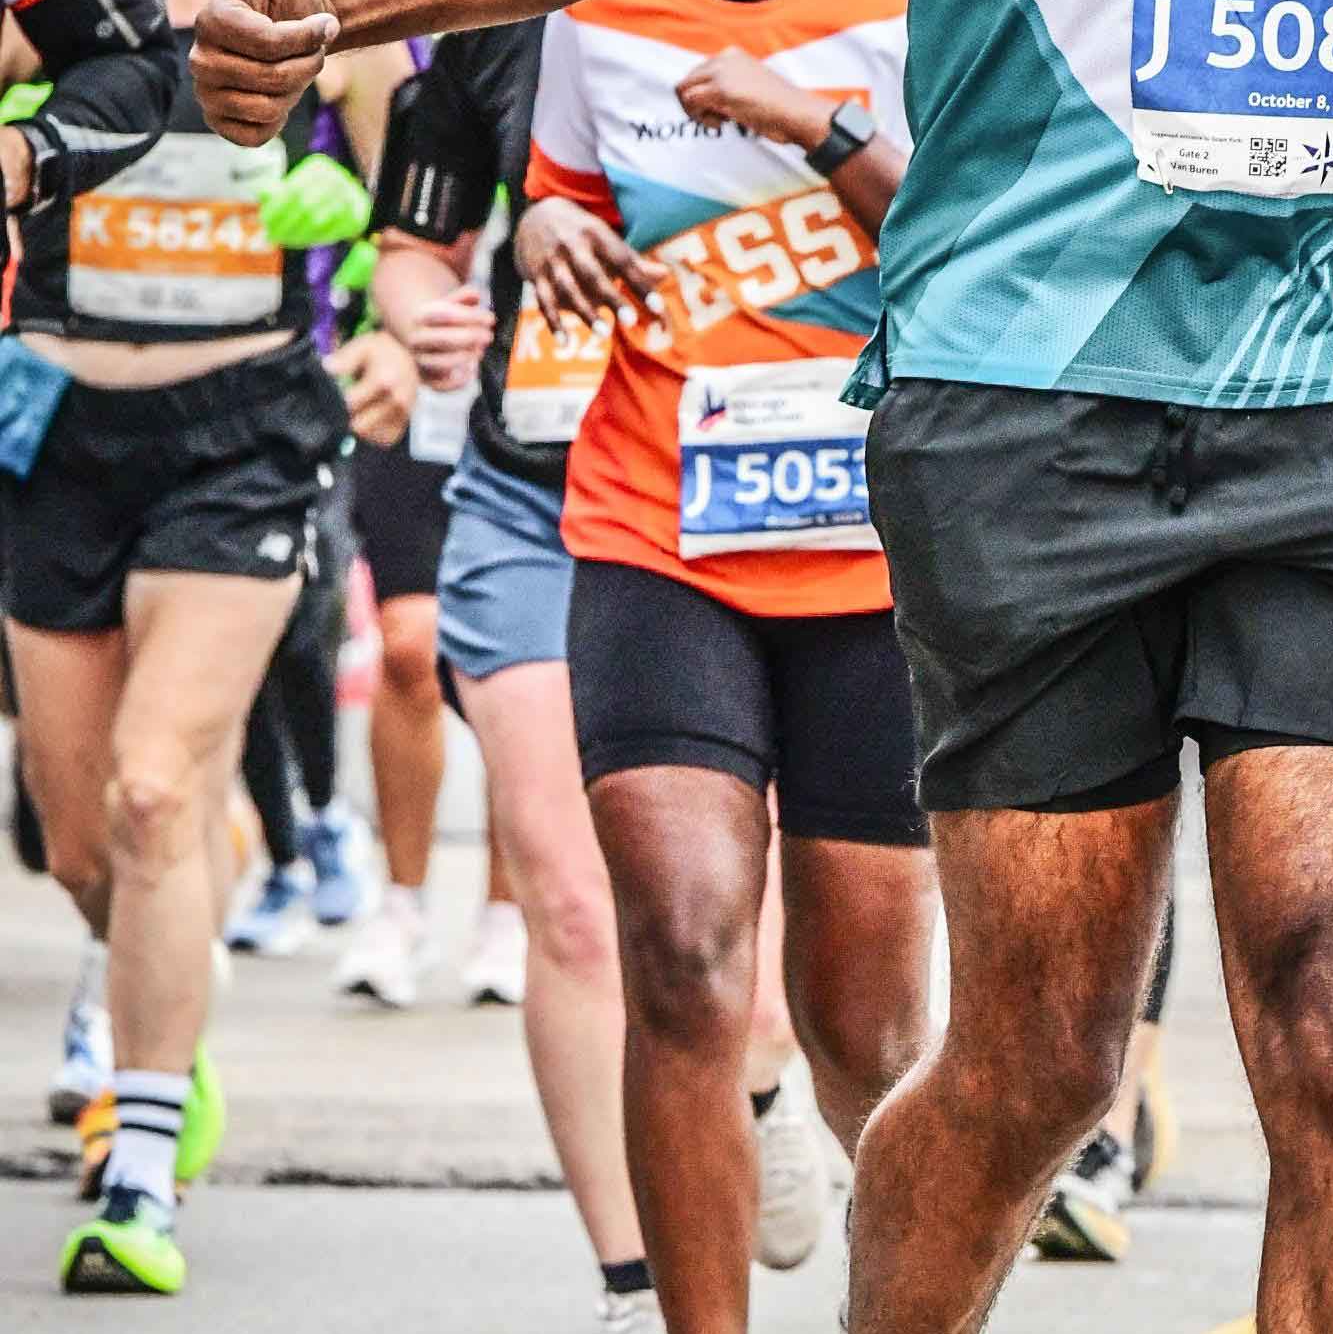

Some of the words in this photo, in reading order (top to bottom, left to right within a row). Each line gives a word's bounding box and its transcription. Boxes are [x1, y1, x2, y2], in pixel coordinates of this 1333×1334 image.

[1247, 91, 1313, 109] October
[1316, 94, 1331, 112] 8,
[1179, 148, 1201, 160] Gate
[1203, 151, 1210, 160] 2
[1189, 164, 1219, 176] Buren
[78, 203, 112, 245] K
[645, 191, 880, 354] ESS
[682, 452, 713, 519] J
